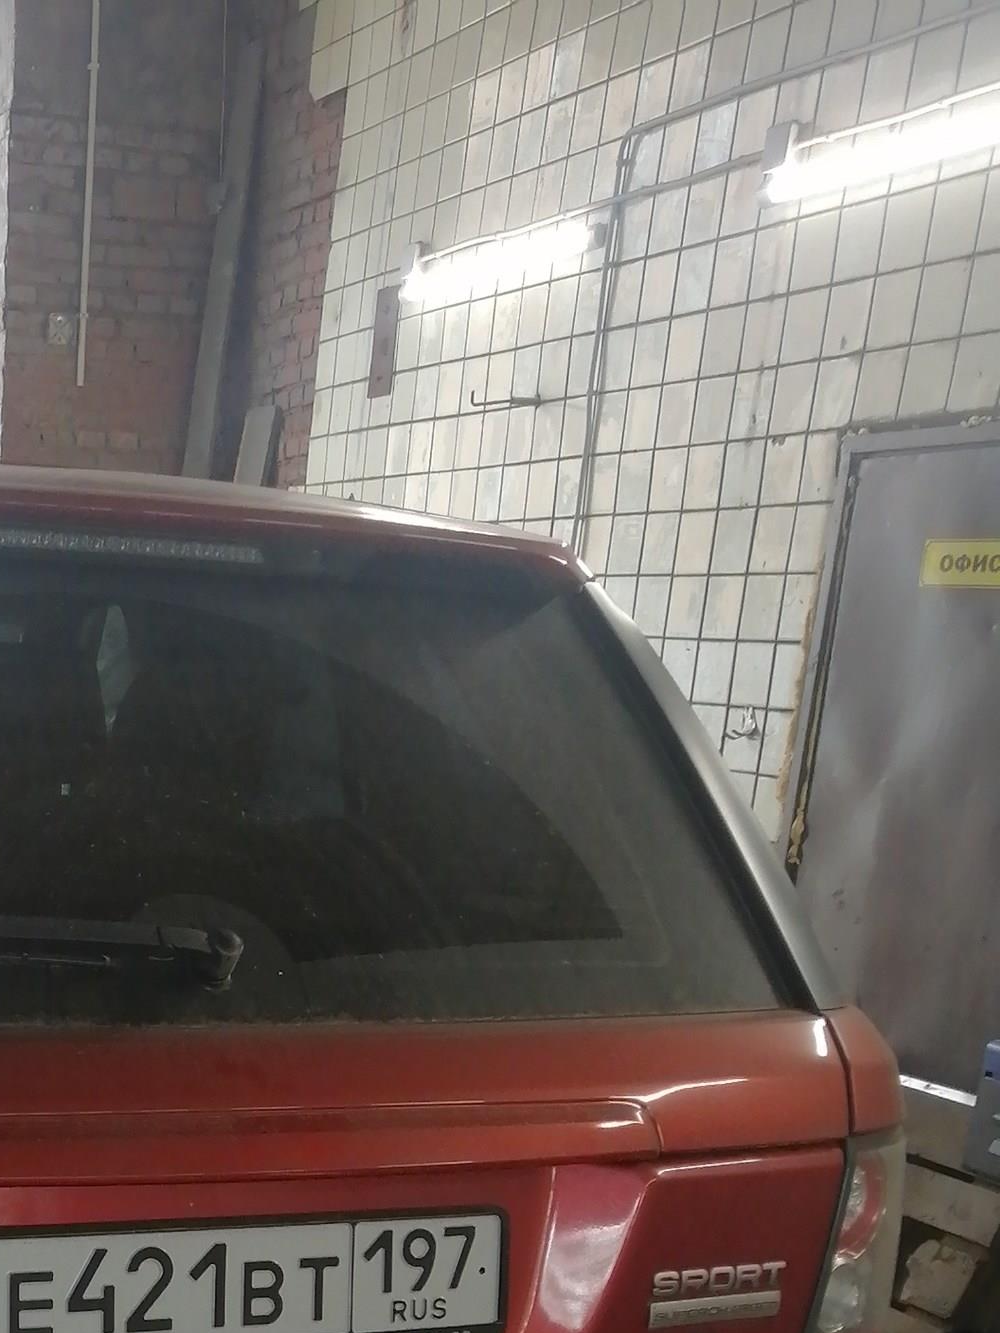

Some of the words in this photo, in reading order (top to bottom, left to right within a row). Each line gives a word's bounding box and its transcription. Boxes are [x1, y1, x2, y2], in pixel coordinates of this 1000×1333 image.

[363, 1225, 476, 1294] 197
[652, 1260, 787, 1296] SPORT
[391, 1297, 447, 1323] RUS
